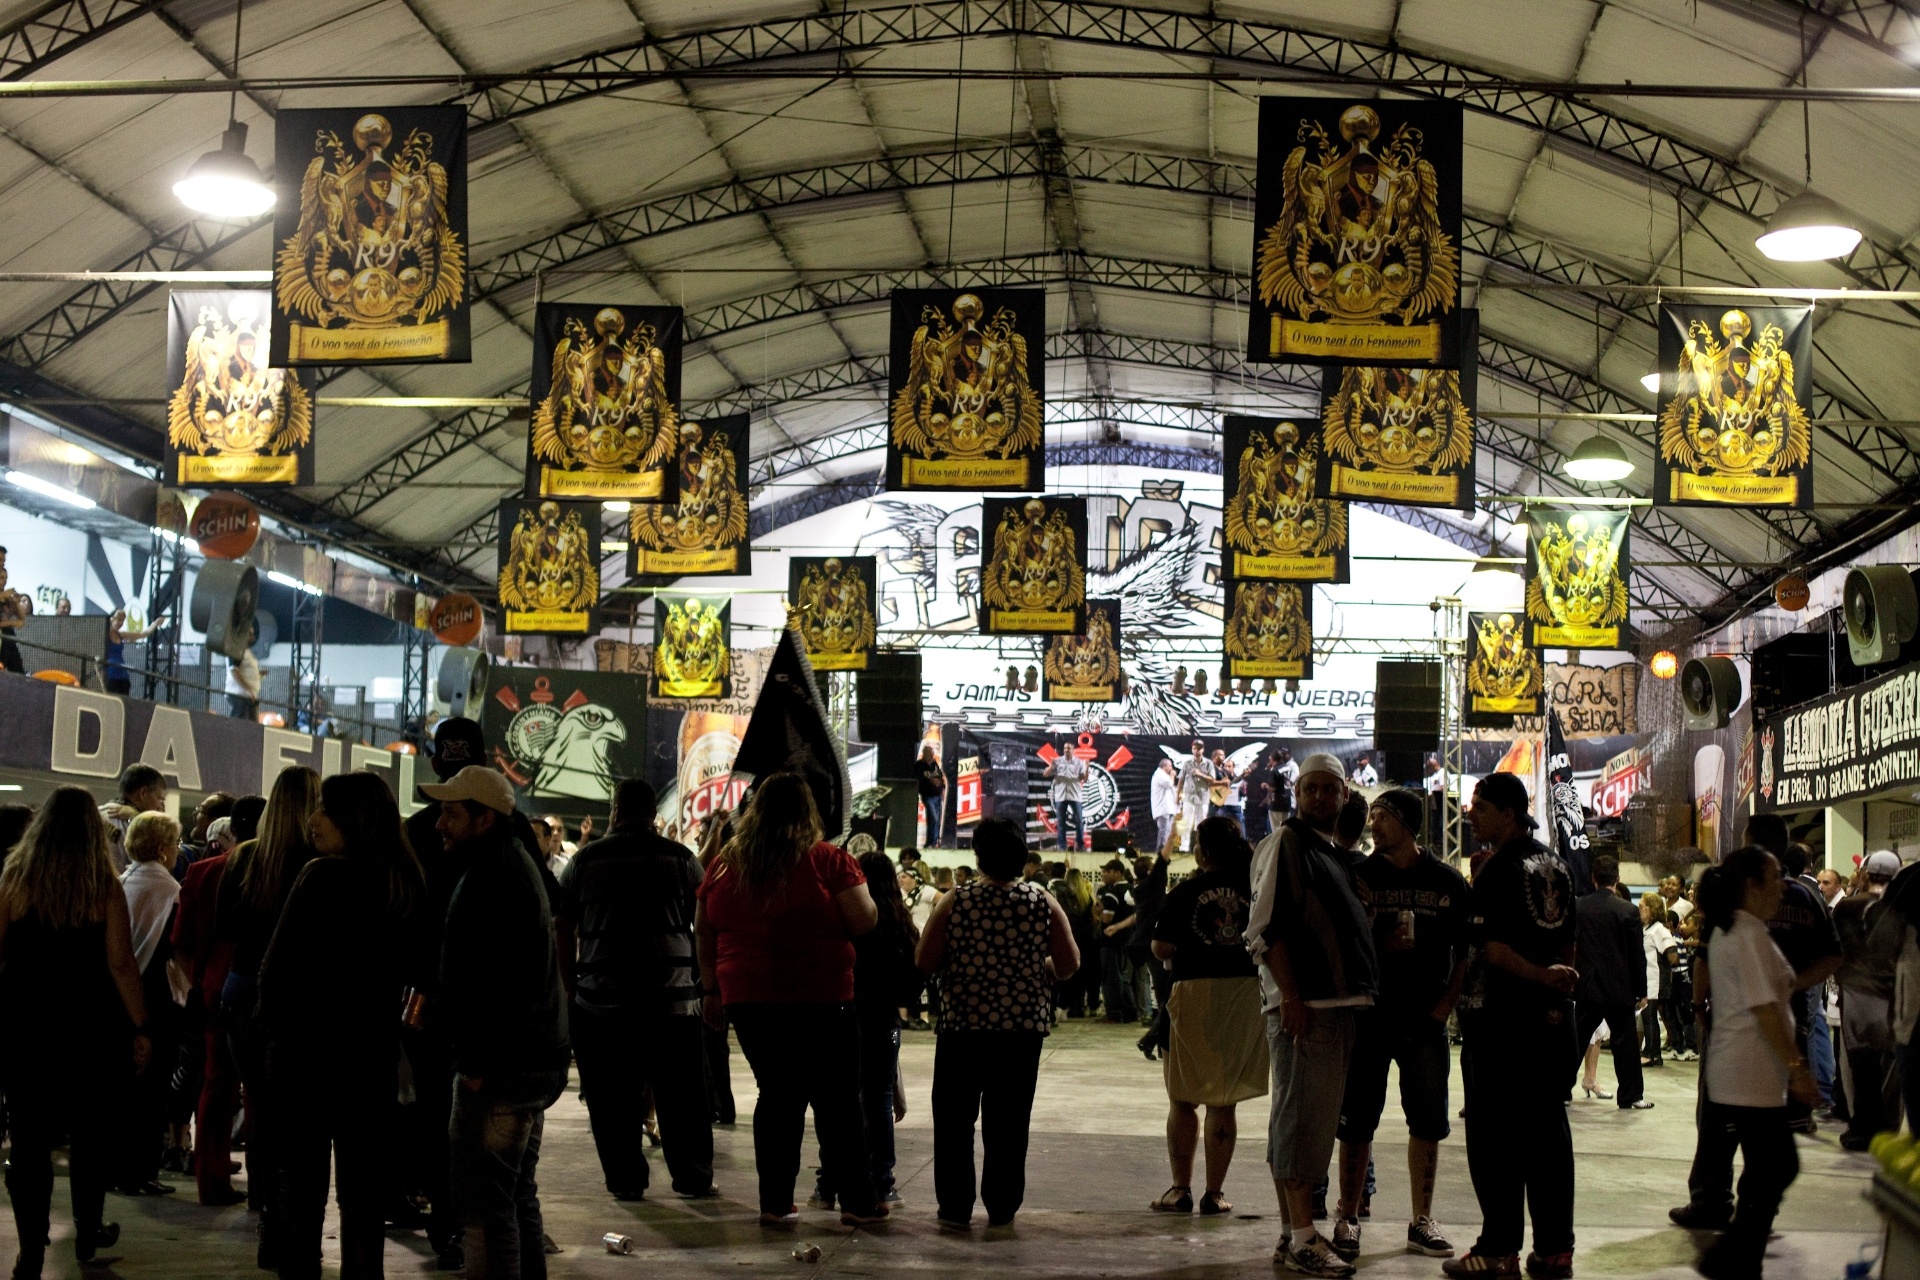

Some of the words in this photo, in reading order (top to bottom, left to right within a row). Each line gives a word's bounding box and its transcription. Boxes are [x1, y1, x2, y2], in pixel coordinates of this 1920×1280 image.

[355, 243, 396, 269] R9
[1338, 238, 1382, 263] R9
[1292, 330, 1300, 342] O
[1303, 335, 1322, 345] voo
[1324, 334, 1348, 346] real
[1350, 335, 1364, 347] do
[226, 393, 260, 412] R9
[953, 393, 985, 414] R9
[592, 406, 624, 426] R9
[1382, 406, 1416, 427] R9
[1721, 410, 1753, 430] R9
[918, 467, 926, 476] O
[944, 468, 960, 478] real
[962, 469, 972, 478] do
[1347, 476, 1354, 484] O
[1356, 480, 1370, 488] voo
[1372, 480, 1388, 489] real
[1390, 482, 1401, 490] do
[678, 502, 704, 518] R9
[1274, 503, 1300, 520] R9
[198, 512, 247, 538] SCHIN
[539, 568, 561, 582] R9
[1024, 568, 1046, 581] R9
[1567, 582, 1590, 598] R9
[1781, 588, 1806, 599] SCHIN
[437, 607, 473, 630] SCHIN
[946, 683, 1032, 702] JAMAIS
[1567, 705, 1625, 735] SELVA
[51, 685, 201, 790] DA
[1782, 693, 1856, 773] HARMONIA
[702, 763, 731, 779] NOVA
[1610, 753, 1631, 774] NOVA
[1777, 780, 1789, 805] EM
[1791, 772, 1812, 803] PRÓL
[1816, 775, 1826, 801] DO
[1829, 763, 1866, 798] GRANDE
[1868, 748, 1920, 789] CORINTHI
[1593, 765, 1652, 816] SCHIN
